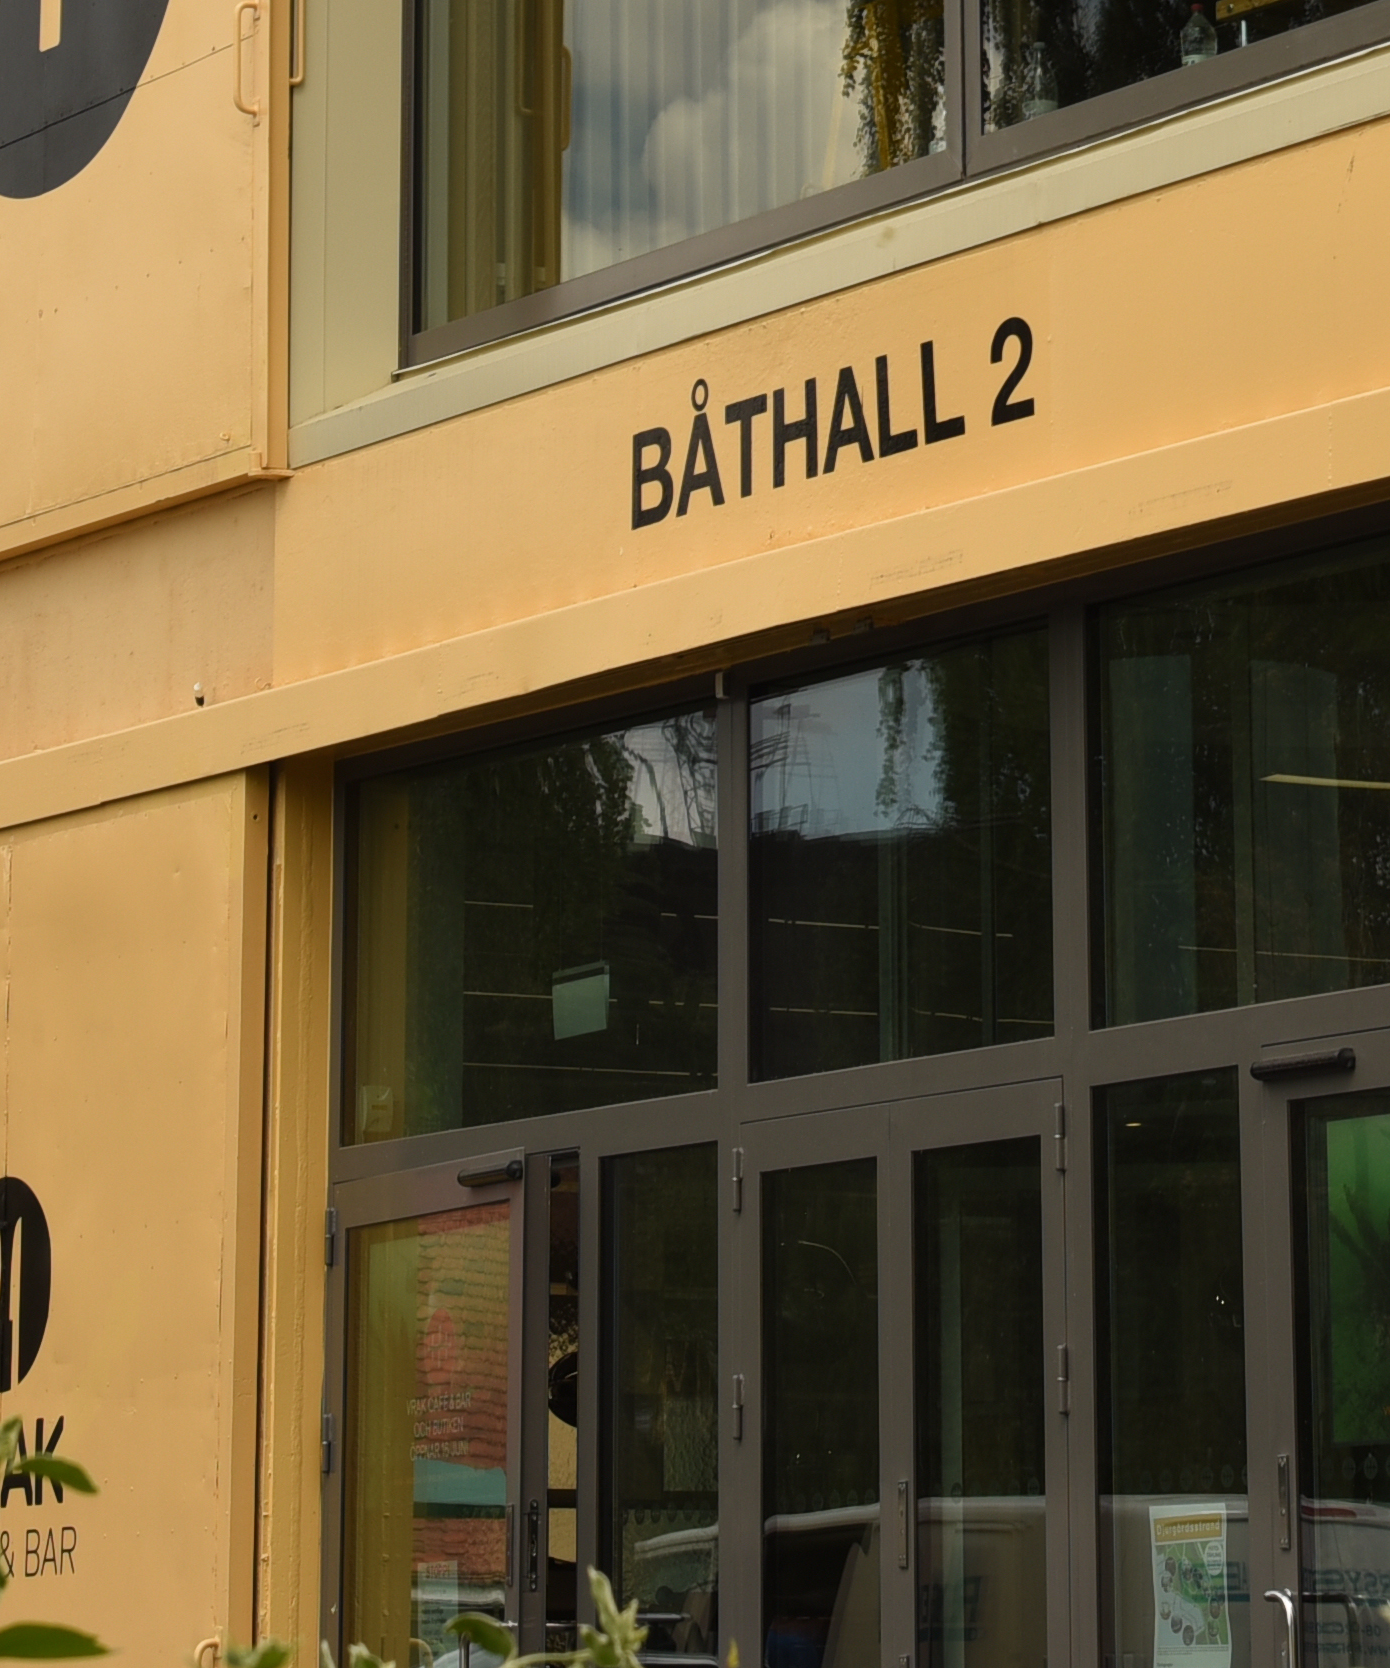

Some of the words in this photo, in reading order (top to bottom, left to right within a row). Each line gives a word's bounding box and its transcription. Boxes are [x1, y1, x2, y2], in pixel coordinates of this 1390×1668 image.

[630, 339, 966, 532] BÅTHALL
[989, 316, 1036, 427] 2
[0, 1530, 15, 1579] &
[24, 1525, 78, 1578] BAR
